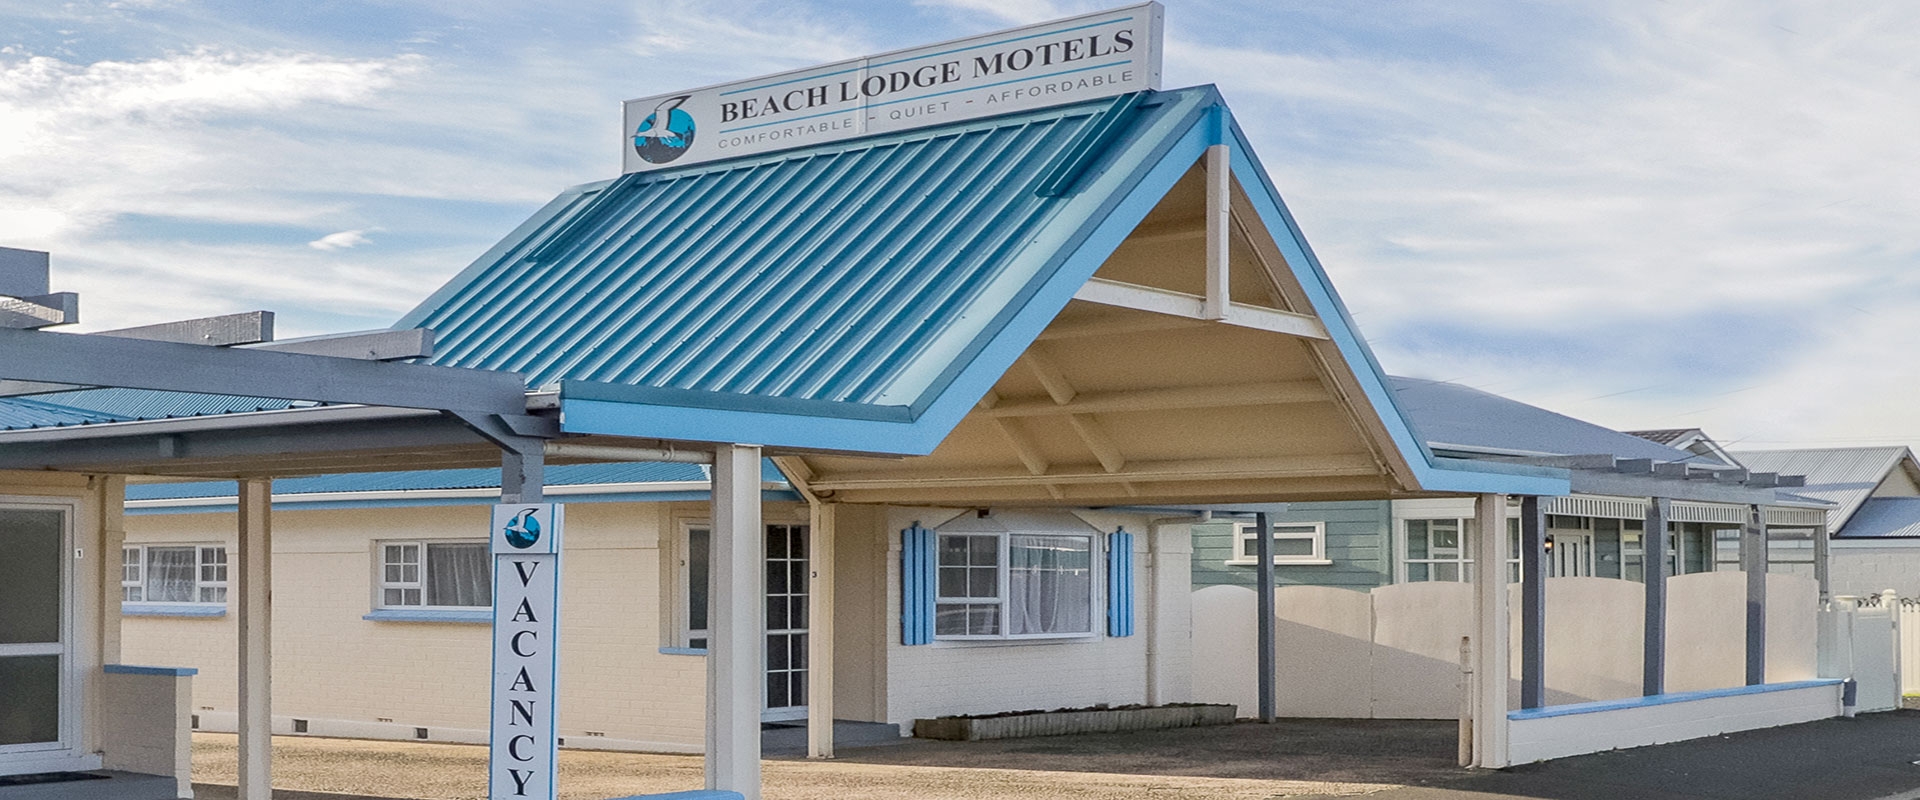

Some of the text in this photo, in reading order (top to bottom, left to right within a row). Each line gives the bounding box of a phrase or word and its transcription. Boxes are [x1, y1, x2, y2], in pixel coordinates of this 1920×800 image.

[718, 118, 853, 149] COMFORTABLE
[889, 101, 950, 121] QUIET
[986, 70, 1133, 105] AFFORDABLE
[719, 29, 1134, 124] BEACH LODGE MOTELS
[507, 561, 540, 797] VACANCY
